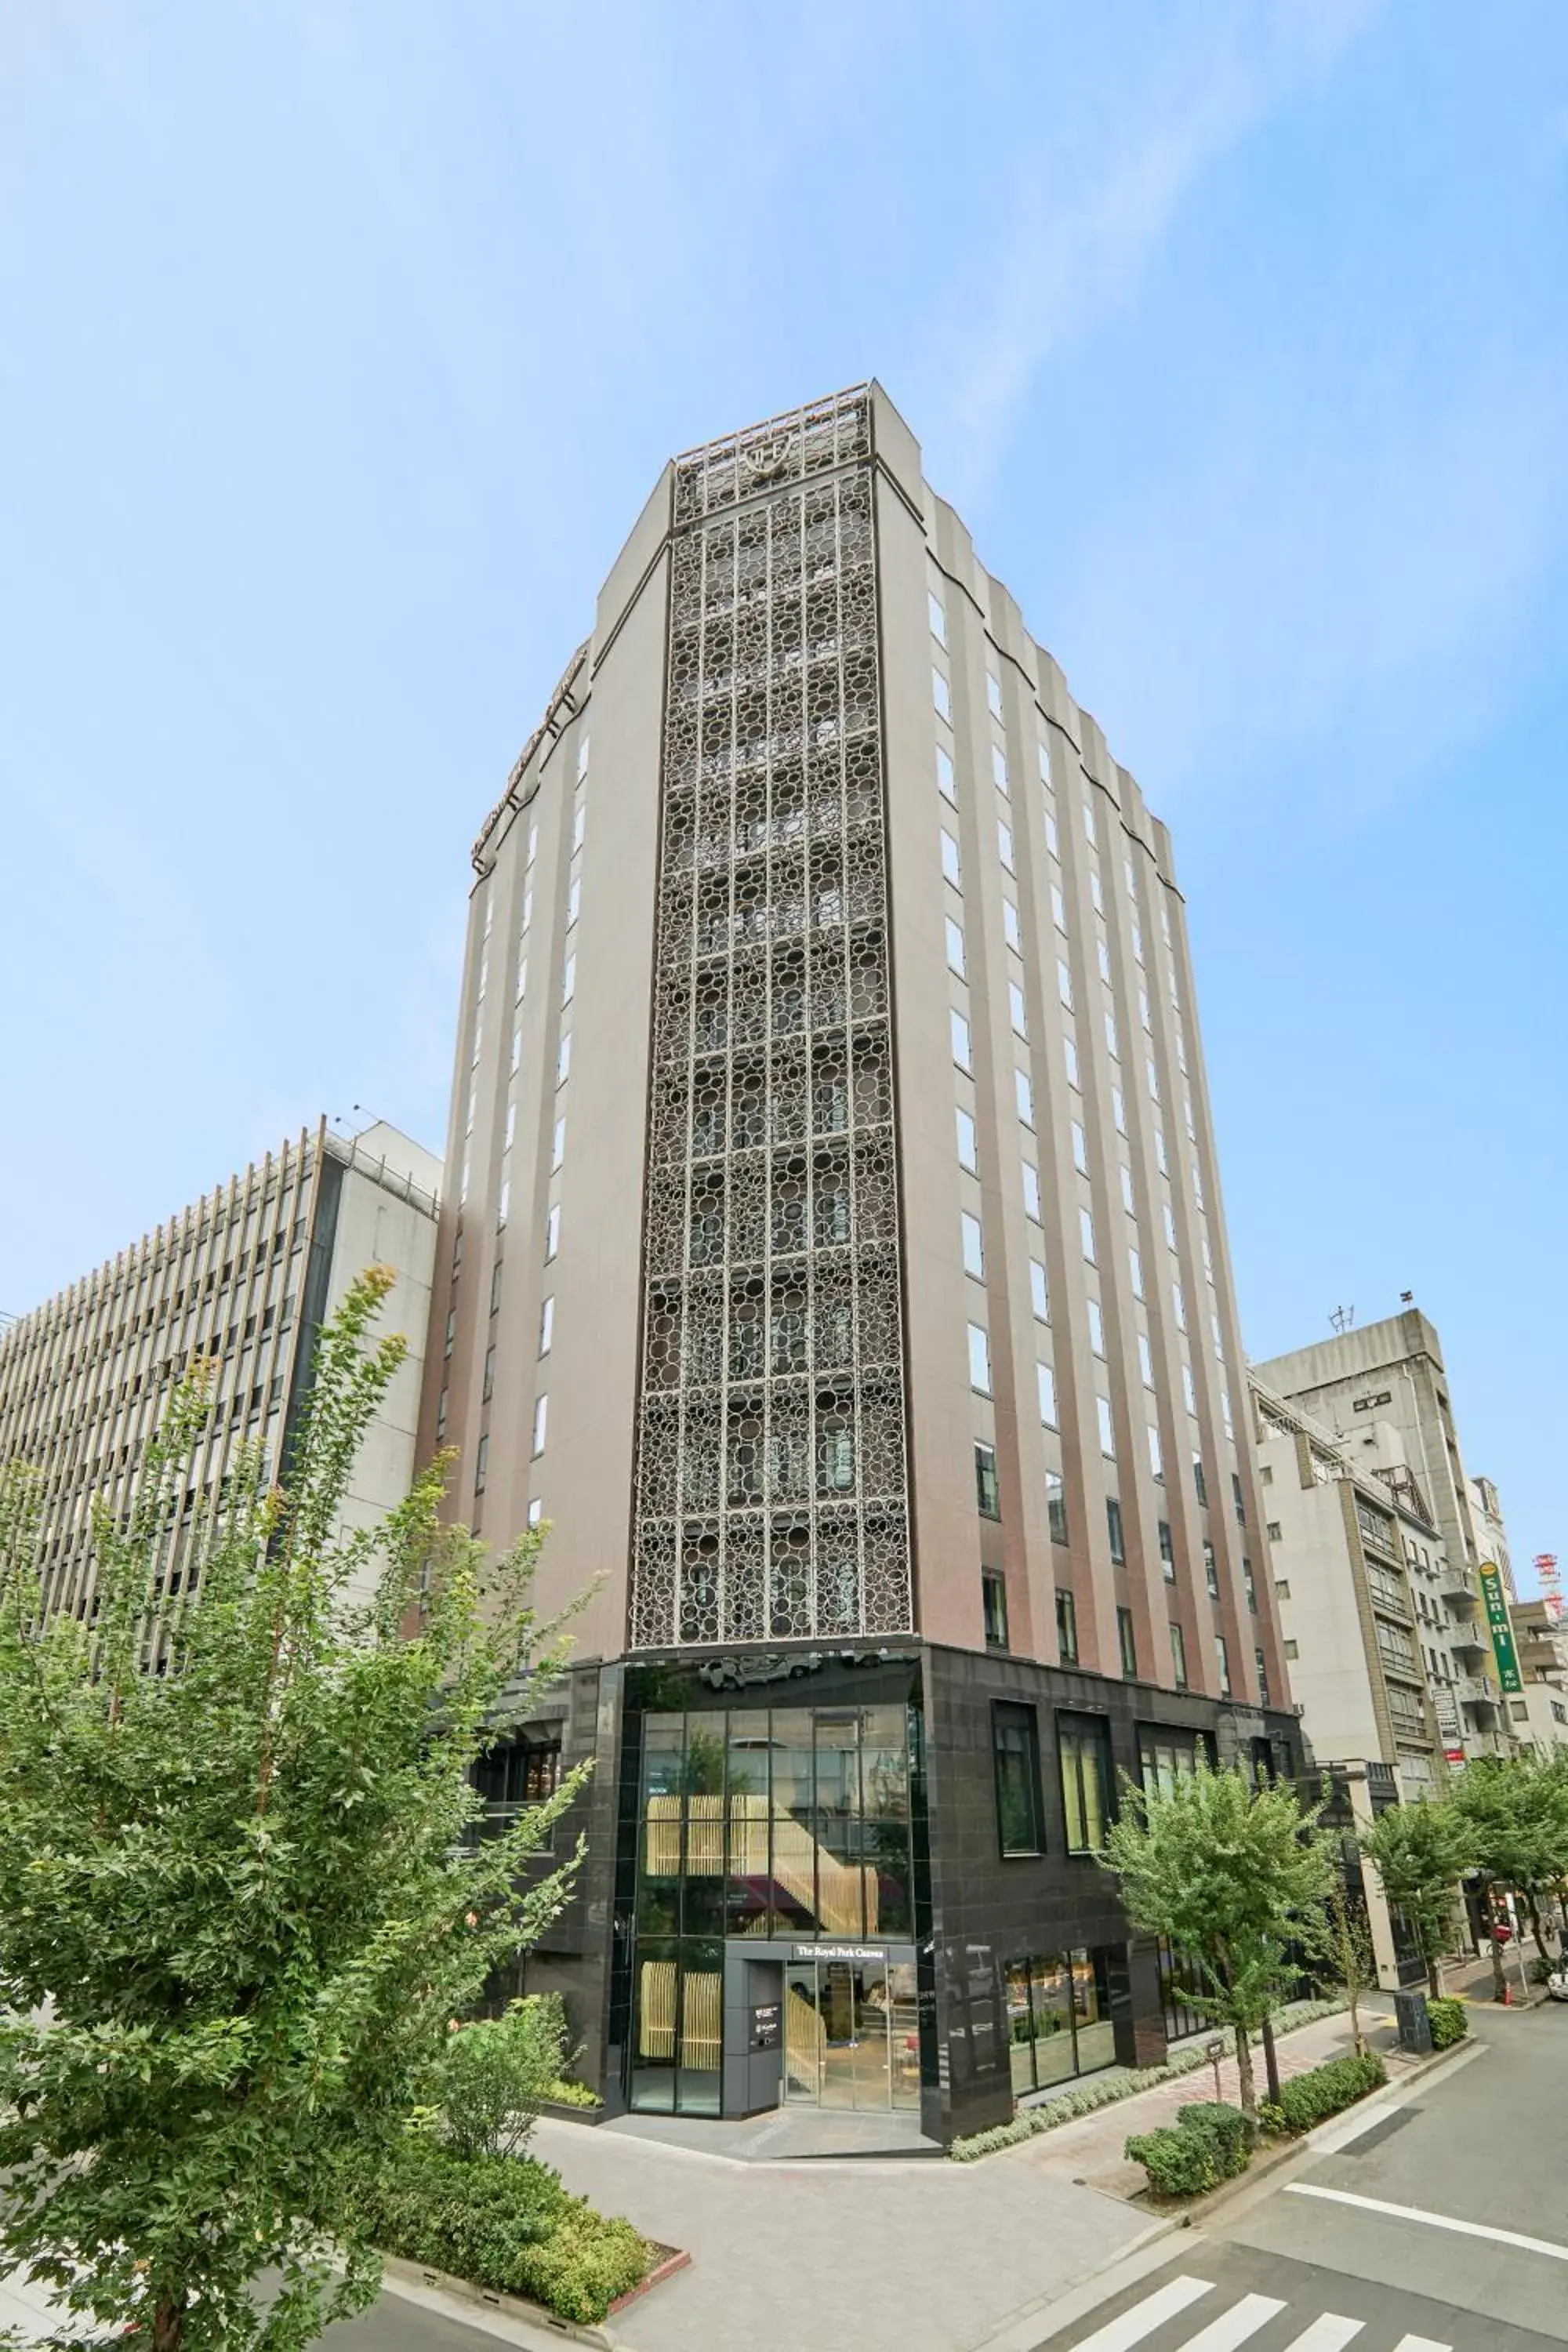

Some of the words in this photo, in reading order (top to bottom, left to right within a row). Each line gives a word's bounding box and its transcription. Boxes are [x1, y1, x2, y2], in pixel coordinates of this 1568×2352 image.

[797, 1946, 812, 1956] The
[815, 1946, 836, 1958] Royal
[837, 1947, 854, 1957] Park
